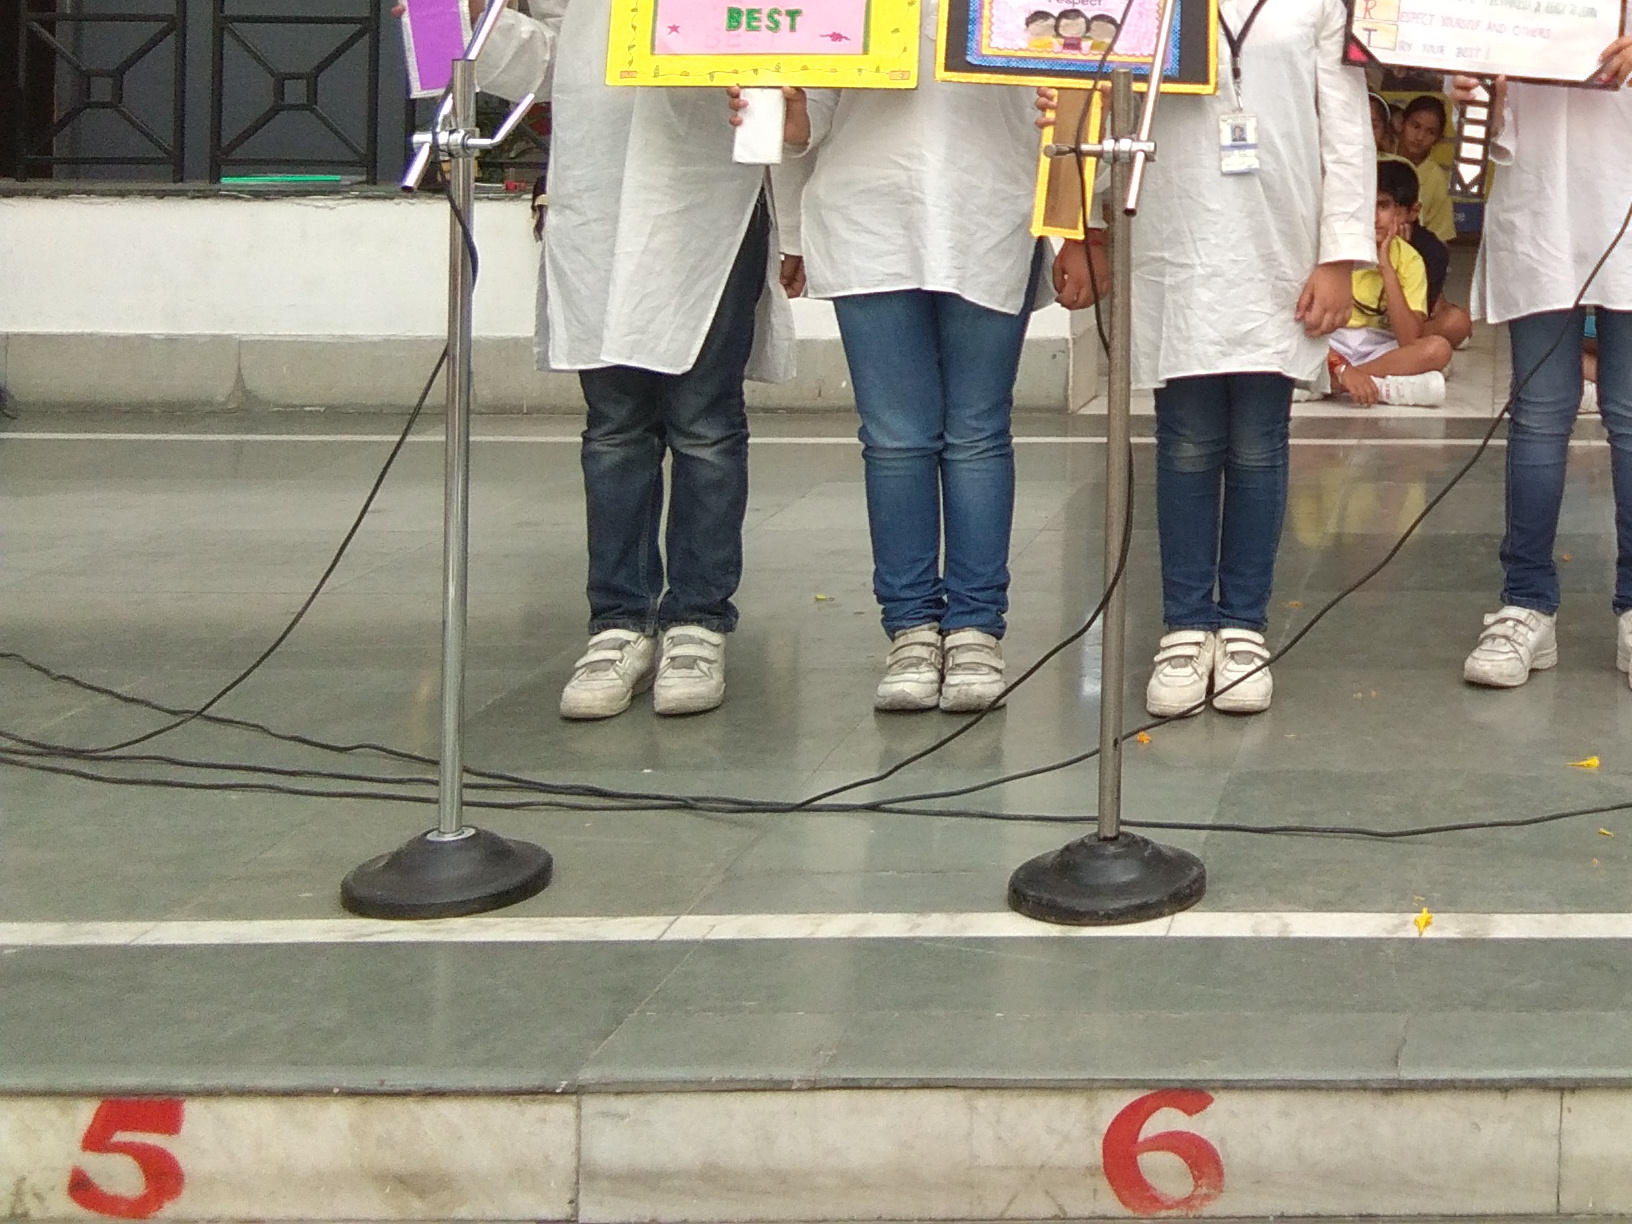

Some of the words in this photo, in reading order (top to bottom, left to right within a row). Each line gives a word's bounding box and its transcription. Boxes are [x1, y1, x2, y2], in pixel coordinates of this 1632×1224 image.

[725, 6, 803, 32] BEST
[1362, 27, 1378, 48] T
[67, 1097, 186, 1220] 5
[1102, 1087, 1225, 1216] 6
